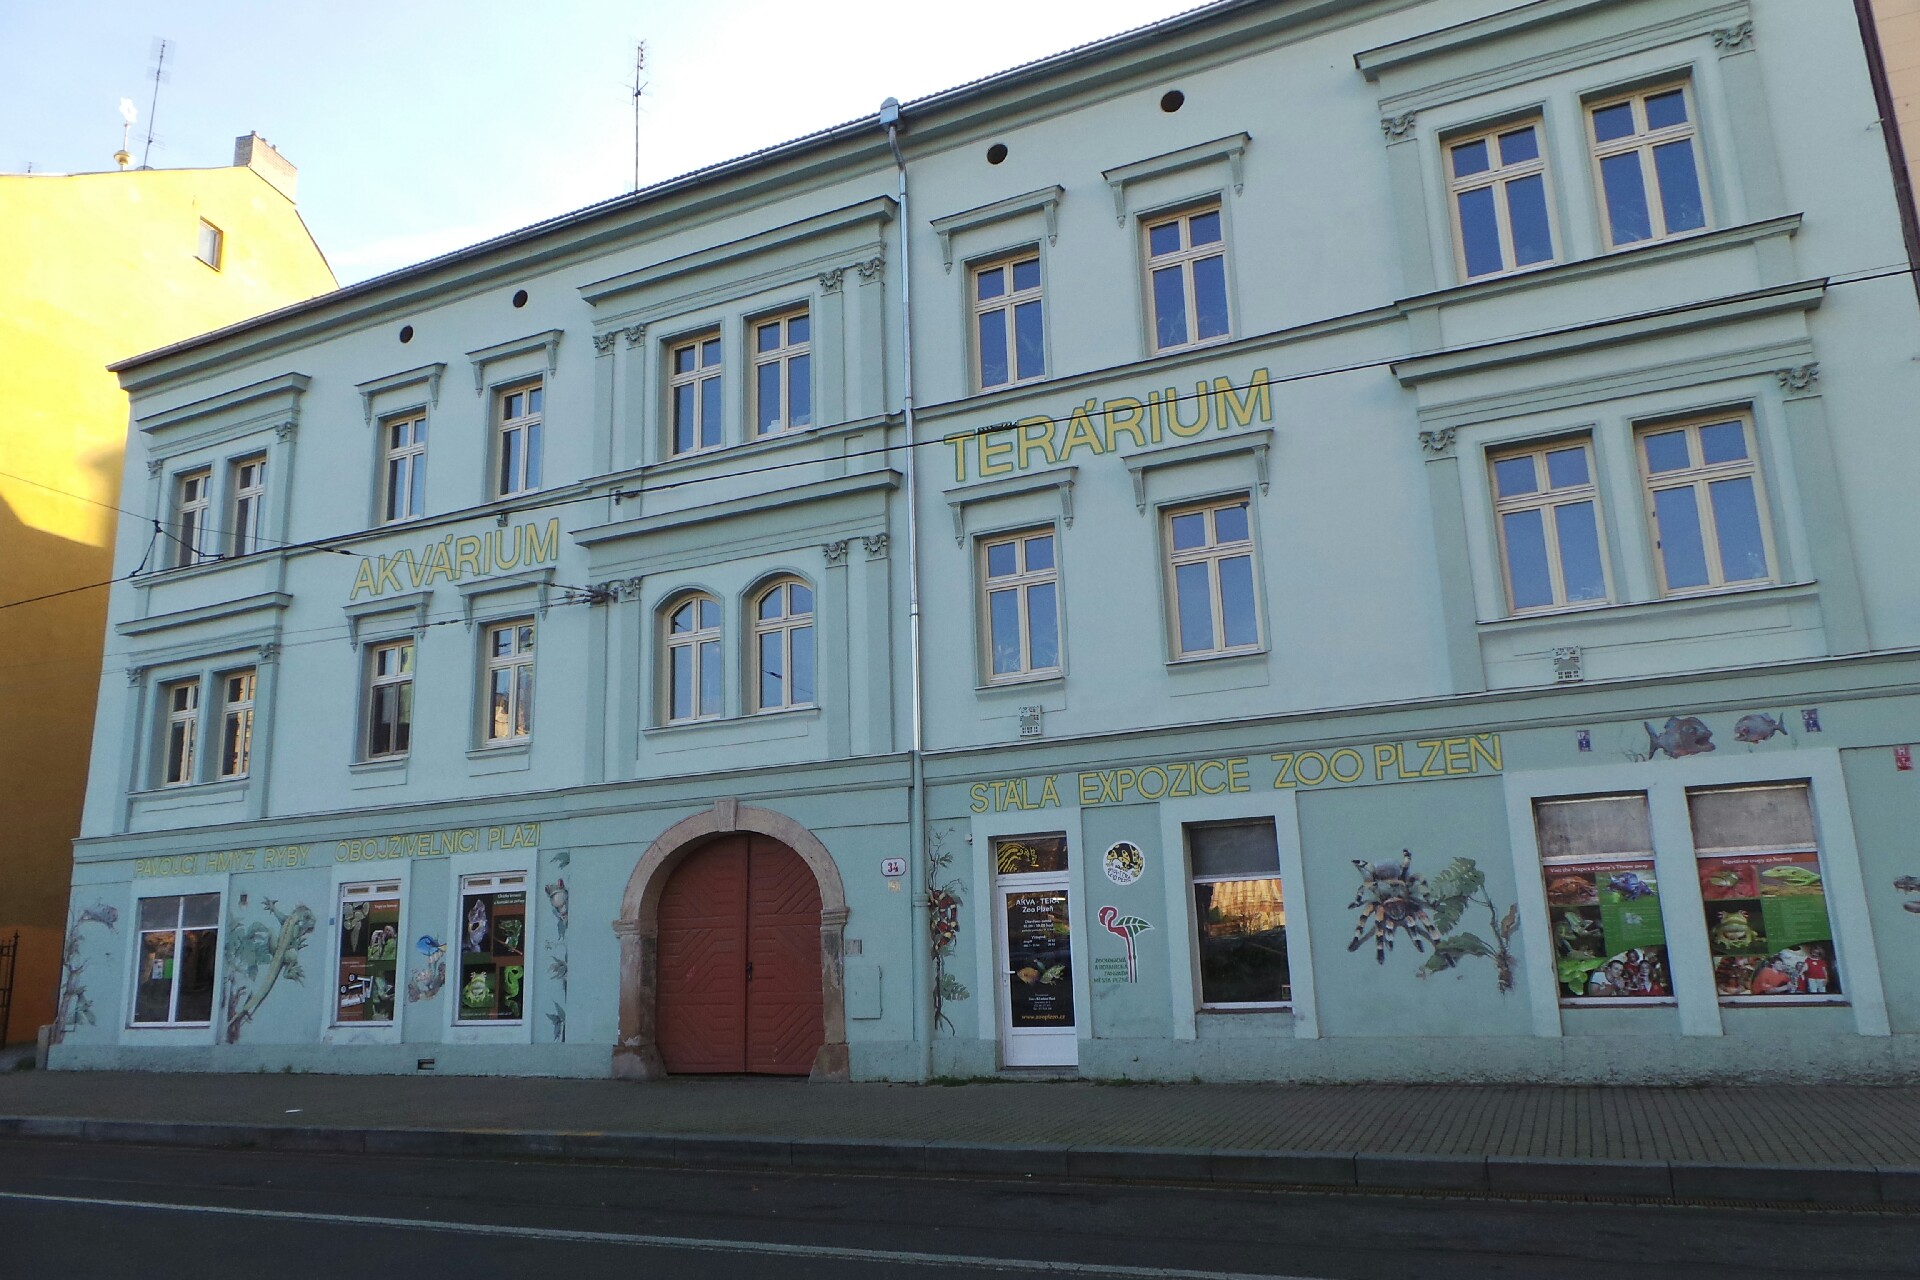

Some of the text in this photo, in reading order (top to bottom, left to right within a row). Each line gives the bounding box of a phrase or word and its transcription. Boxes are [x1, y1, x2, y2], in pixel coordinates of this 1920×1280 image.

[943, 367, 1273, 482] TERÁRIUM
[350, 517, 559, 600] AKVÁRIUM
[970, 733, 1503, 813] STÁLÁ EXPOZICE ZOO PLZEŇ
[134, 845, 311, 878] PAVOUCI HMYZ RYBY
[887, 862, 899, 873] 34
[1015, 898, 1036, 906] AKVA
